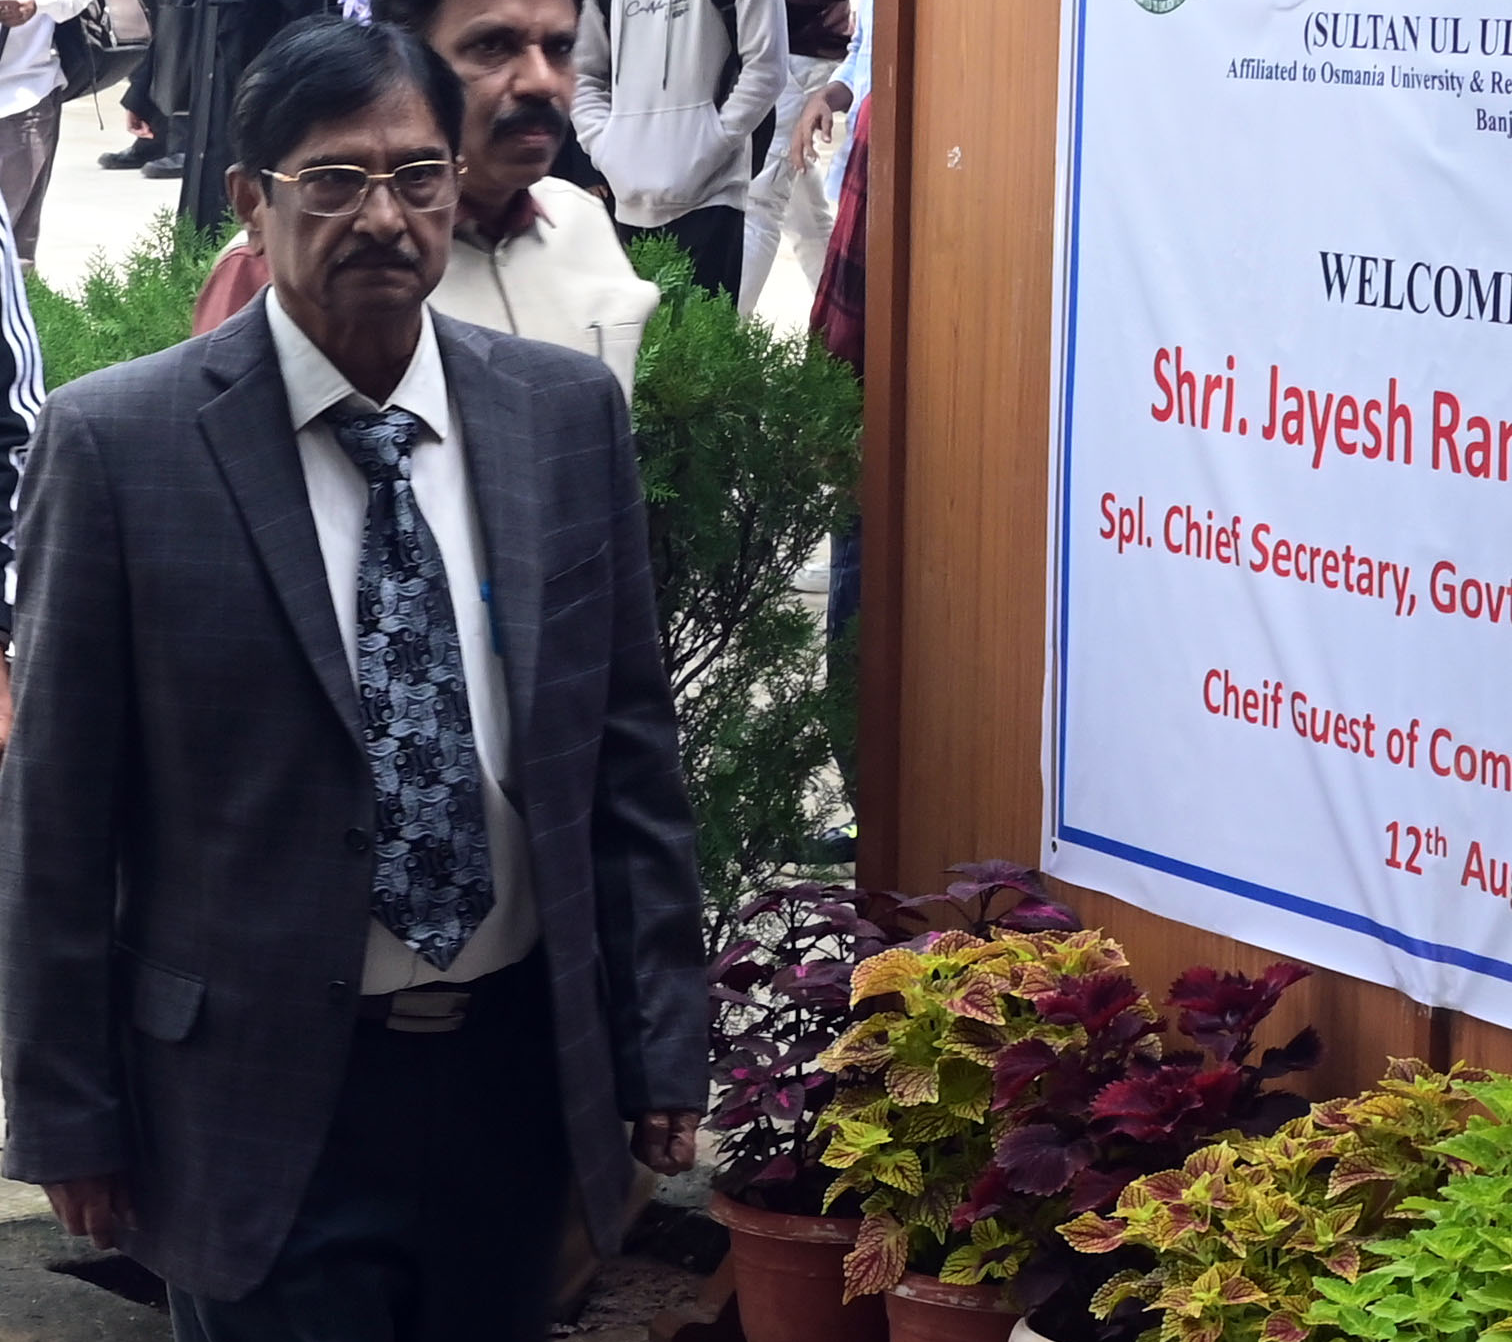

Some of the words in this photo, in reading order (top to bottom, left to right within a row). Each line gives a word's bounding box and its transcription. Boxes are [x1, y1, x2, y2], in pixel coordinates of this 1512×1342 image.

[1226, 58, 1297, 81] Affiliated
[1303, 64, 1316, 82] to
[1321, 62, 1384, 86] Osmania
[1391, 66, 1464, 98] University
[1470, 70, 1484, 92] &
[1304, 12, 1420, 54] (SULTAN
[1430, 17, 1470, 54] UL
[1152, 346, 1247, 435] Shri.
[1262, 365, 1412, 469] Jayesh
[1100, 493, 1151, 554] Spl.
[1164, 505, 1241, 566] Chief
[1250, 523, 1416, 616] Secretary,
[1204, 669, 1283, 729] Cheif
[1291, 691, 1375, 758] Guest
[1387, 719, 1419, 768] of
